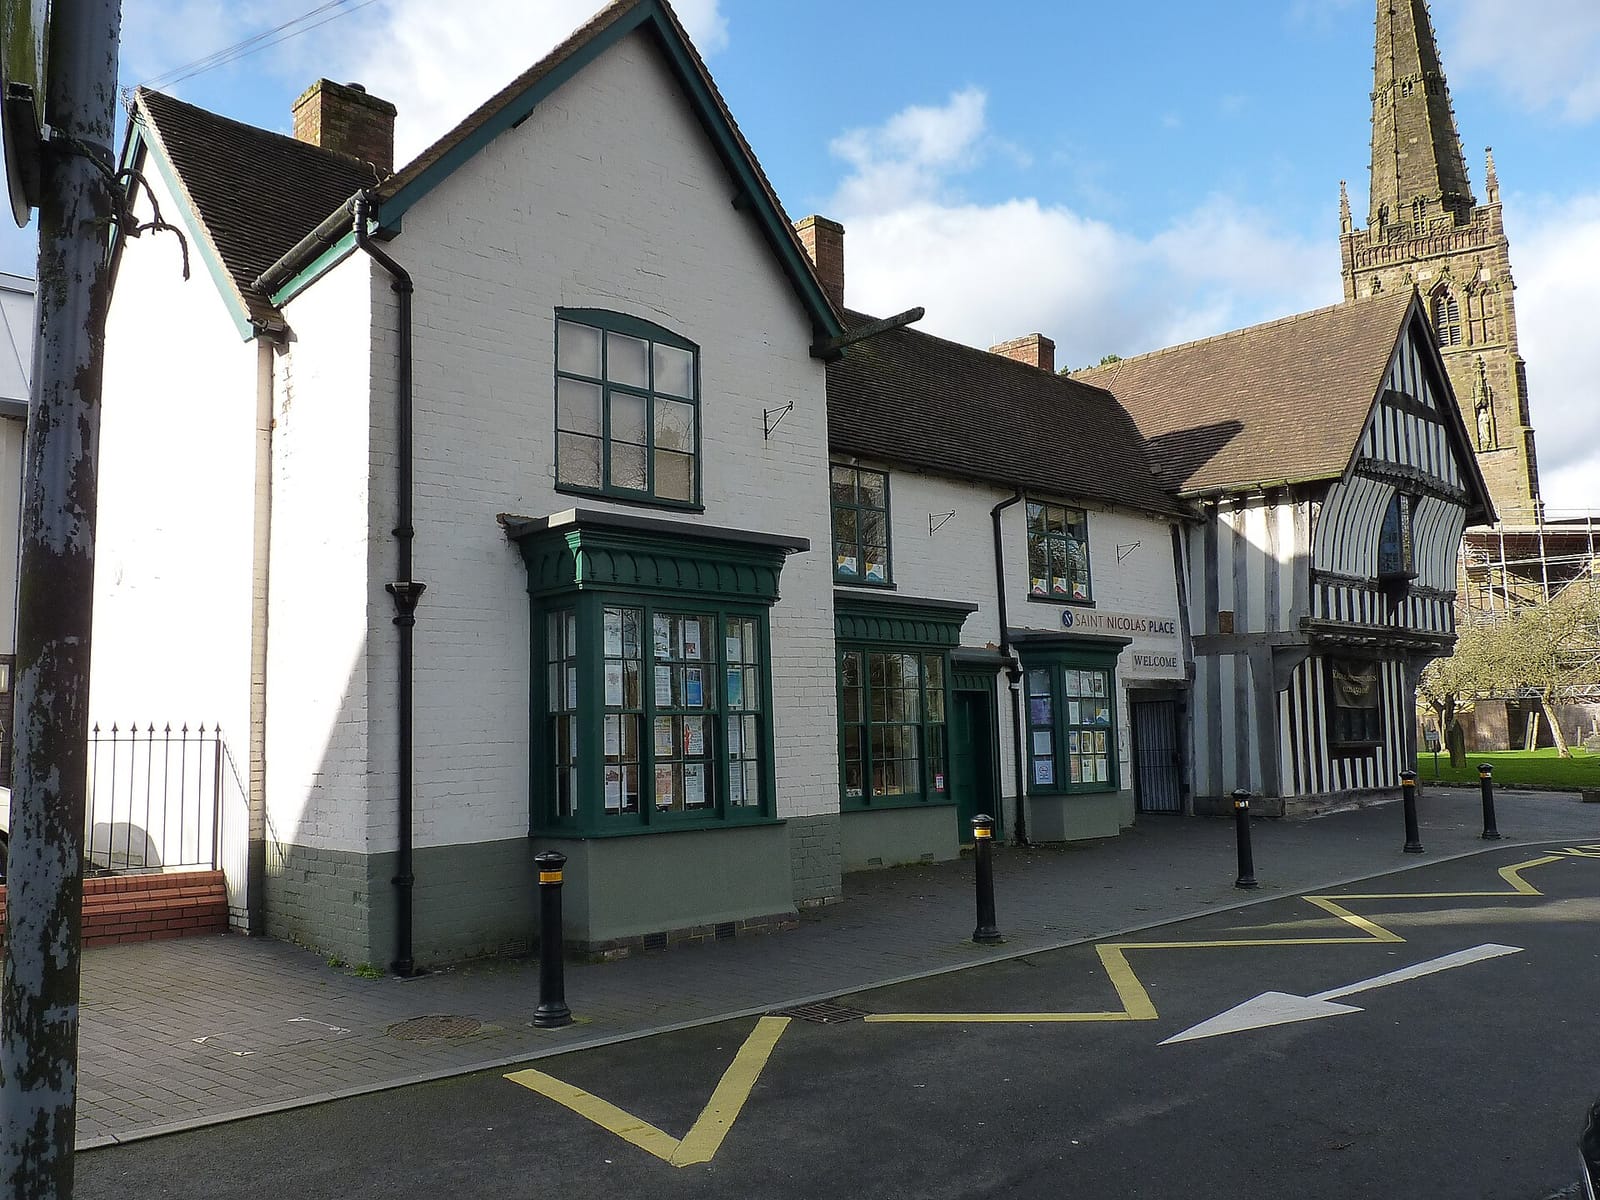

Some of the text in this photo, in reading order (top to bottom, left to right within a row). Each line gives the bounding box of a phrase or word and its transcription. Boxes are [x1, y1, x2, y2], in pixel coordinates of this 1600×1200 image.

[1075, 613, 1104, 629] SAINT
[1107, 616, 1147, 632] NICOLAS
[1149, 620, 1175, 634] PLACE
[1134, 655, 1177, 668] WELCOME
